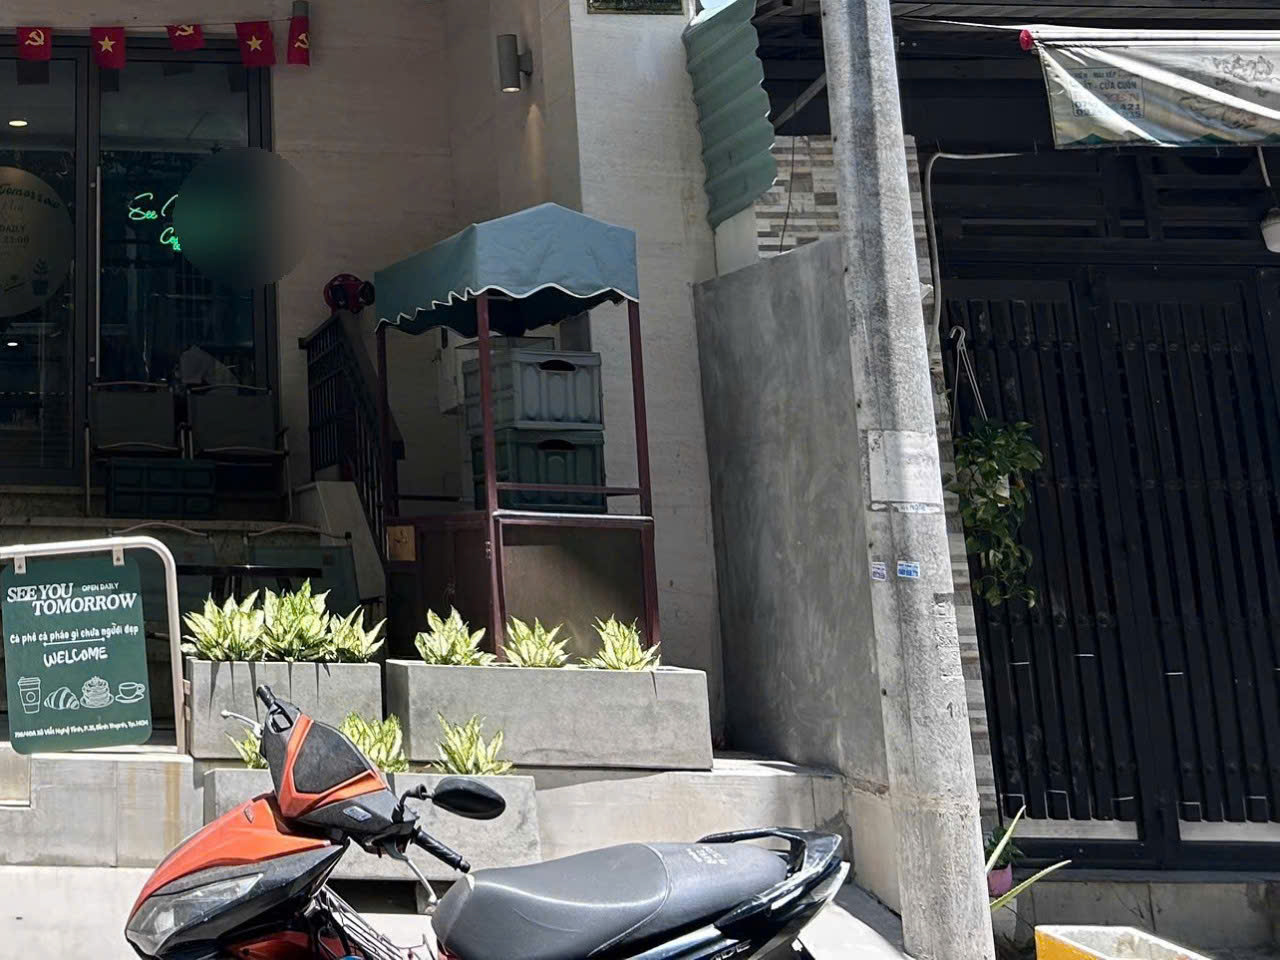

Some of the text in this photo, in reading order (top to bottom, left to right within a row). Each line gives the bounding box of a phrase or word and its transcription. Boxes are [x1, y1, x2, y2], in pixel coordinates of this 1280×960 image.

[0, 224, 26, 233] DAILY
[7, 585, 38, 602] SEE
[38, 583, 74, 600] YOU
[100, 582, 120, 591] DAILY
[32, 593, 138, 616] TOMORROW
[43, 647, 108, 667] WELCOME
